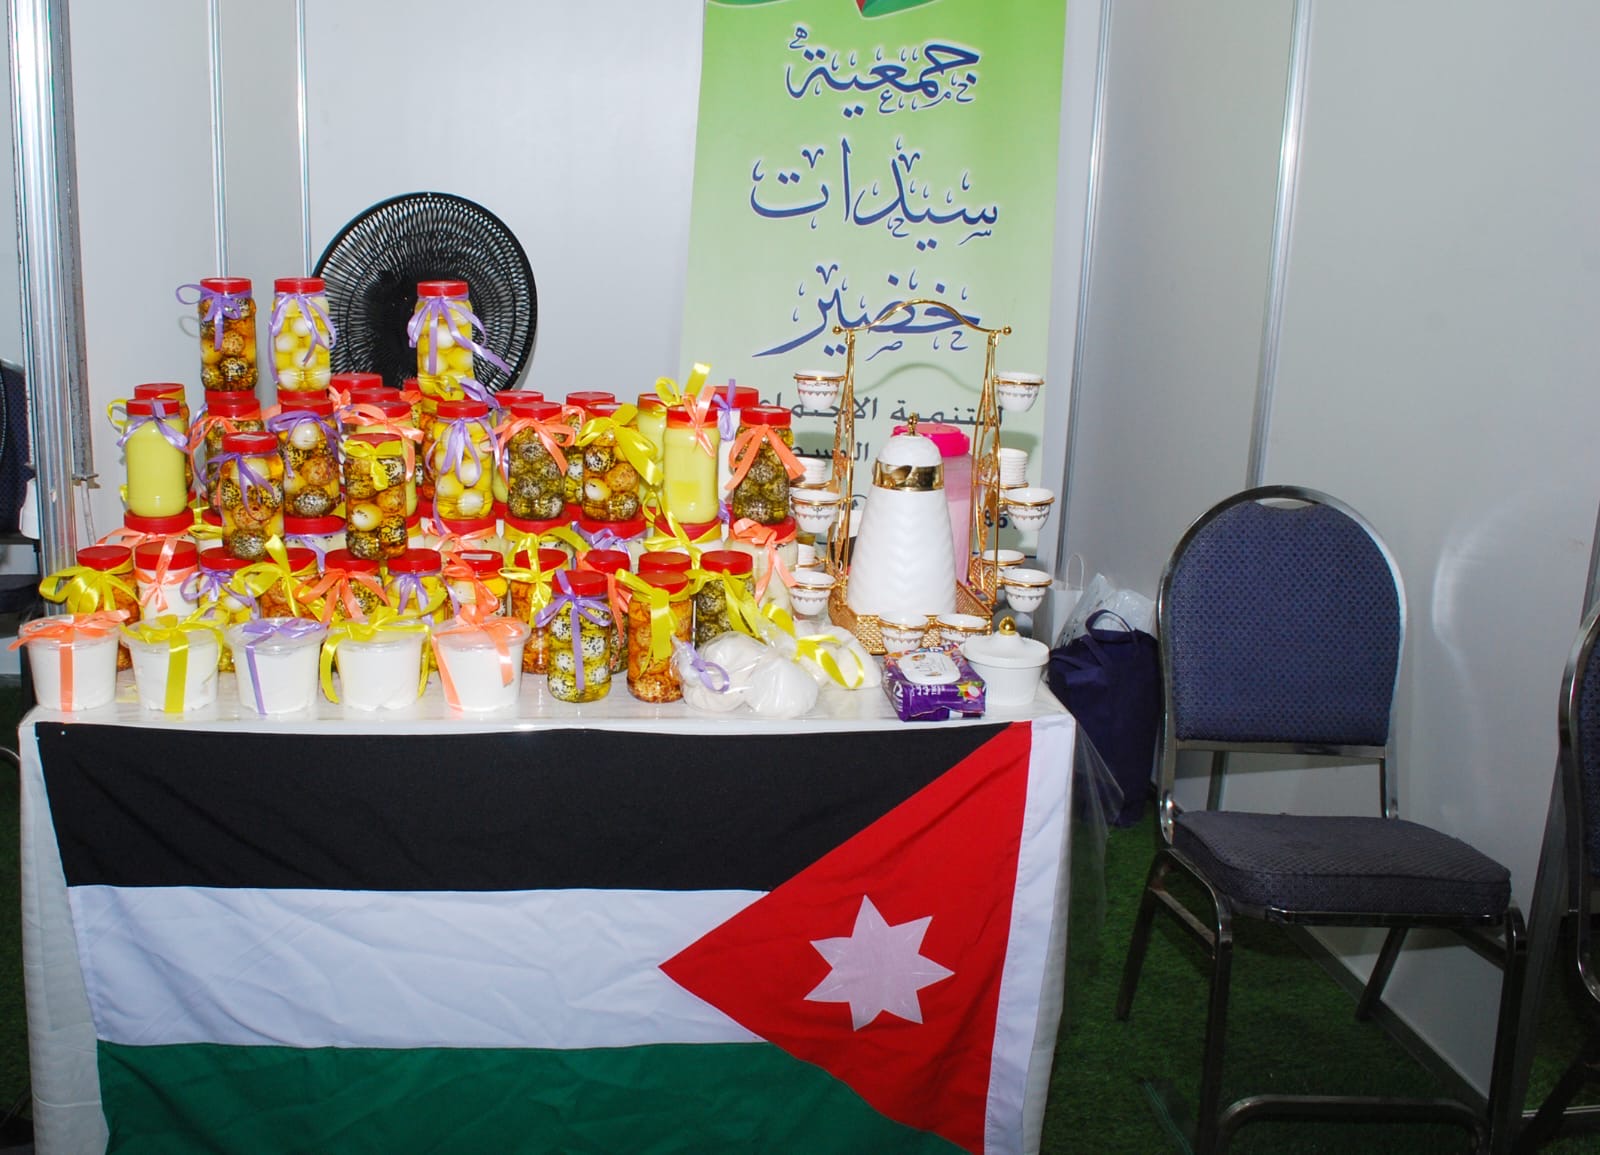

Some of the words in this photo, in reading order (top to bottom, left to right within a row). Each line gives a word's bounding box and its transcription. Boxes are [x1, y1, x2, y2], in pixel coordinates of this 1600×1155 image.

[785, 27, 980, 118] جمعية
[750, 137, 998, 251] سيدات
[751, 264, 981, 361] خضير
